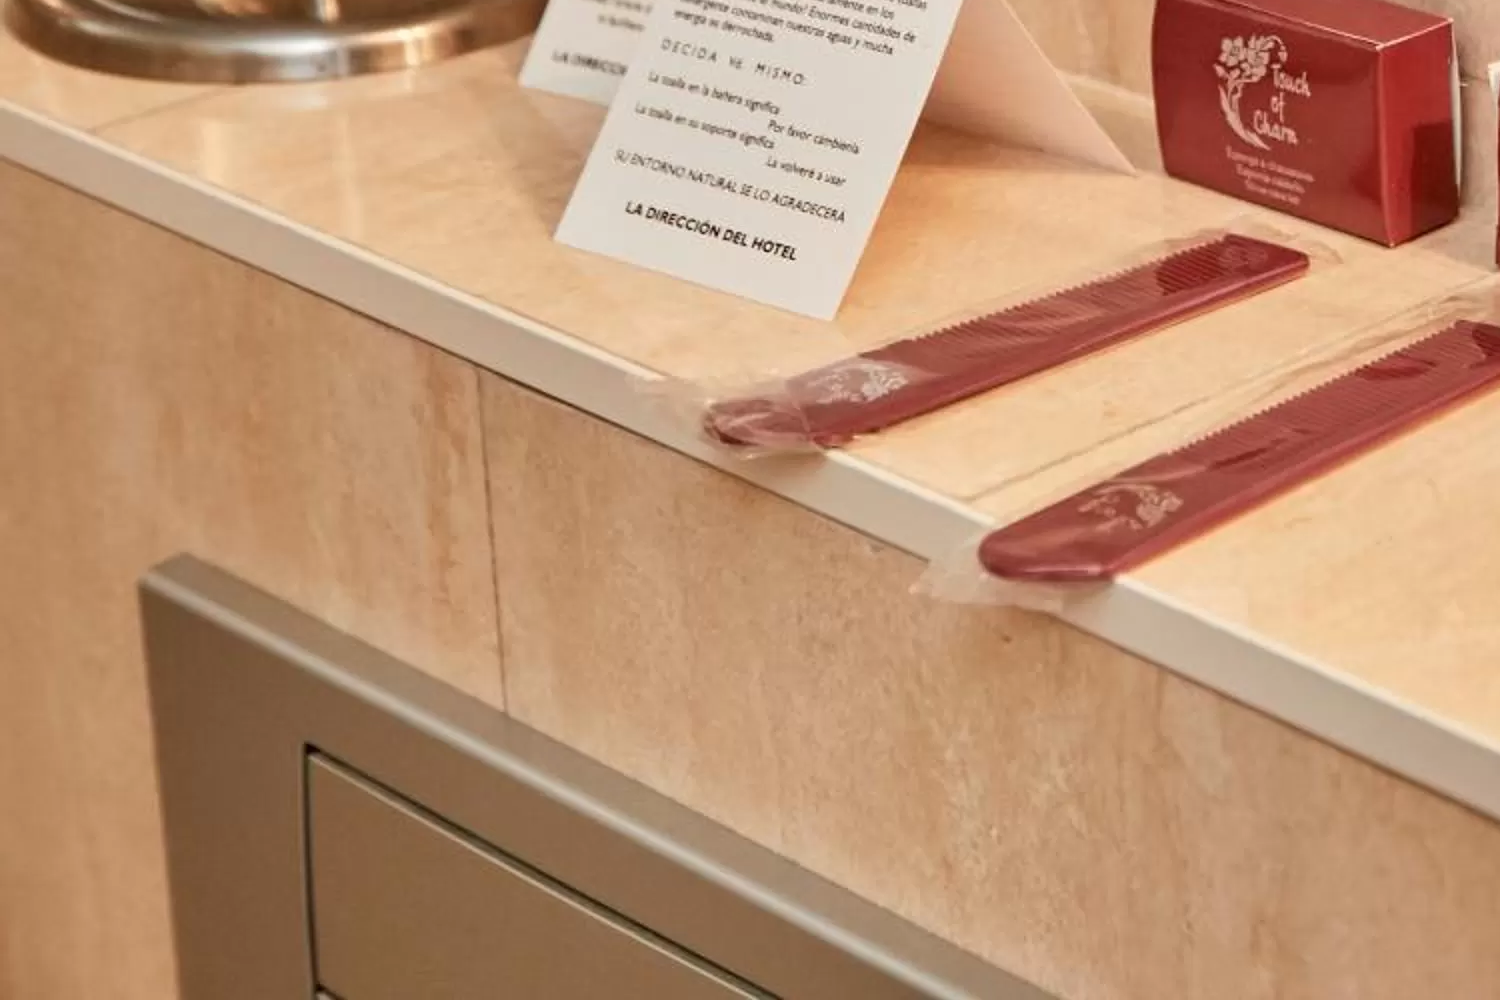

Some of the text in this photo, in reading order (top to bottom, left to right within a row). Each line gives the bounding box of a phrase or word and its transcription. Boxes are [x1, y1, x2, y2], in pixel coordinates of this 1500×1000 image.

[852, 18, 900, 39] cantidades
[903, 30, 916, 43] de
[660, 37, 717, 62] DECIDA
[1271, 63, 1311, 97] Touch
[1271, 91, 1285, 123] of
[768, 118, 785, 133] Por
[787, 124, 812, 140] favor
[1254, 109, 1298, 145] Charm
[629, 151, 685, 178] ENTORNO
[688, 168, 736, 193] NATURAL
[739, 182, 752, 197] SE
[753, 186, 770, 201] LO
[625, 200, 797, 261] LA DIRECCIÓN DEL HOTEL
